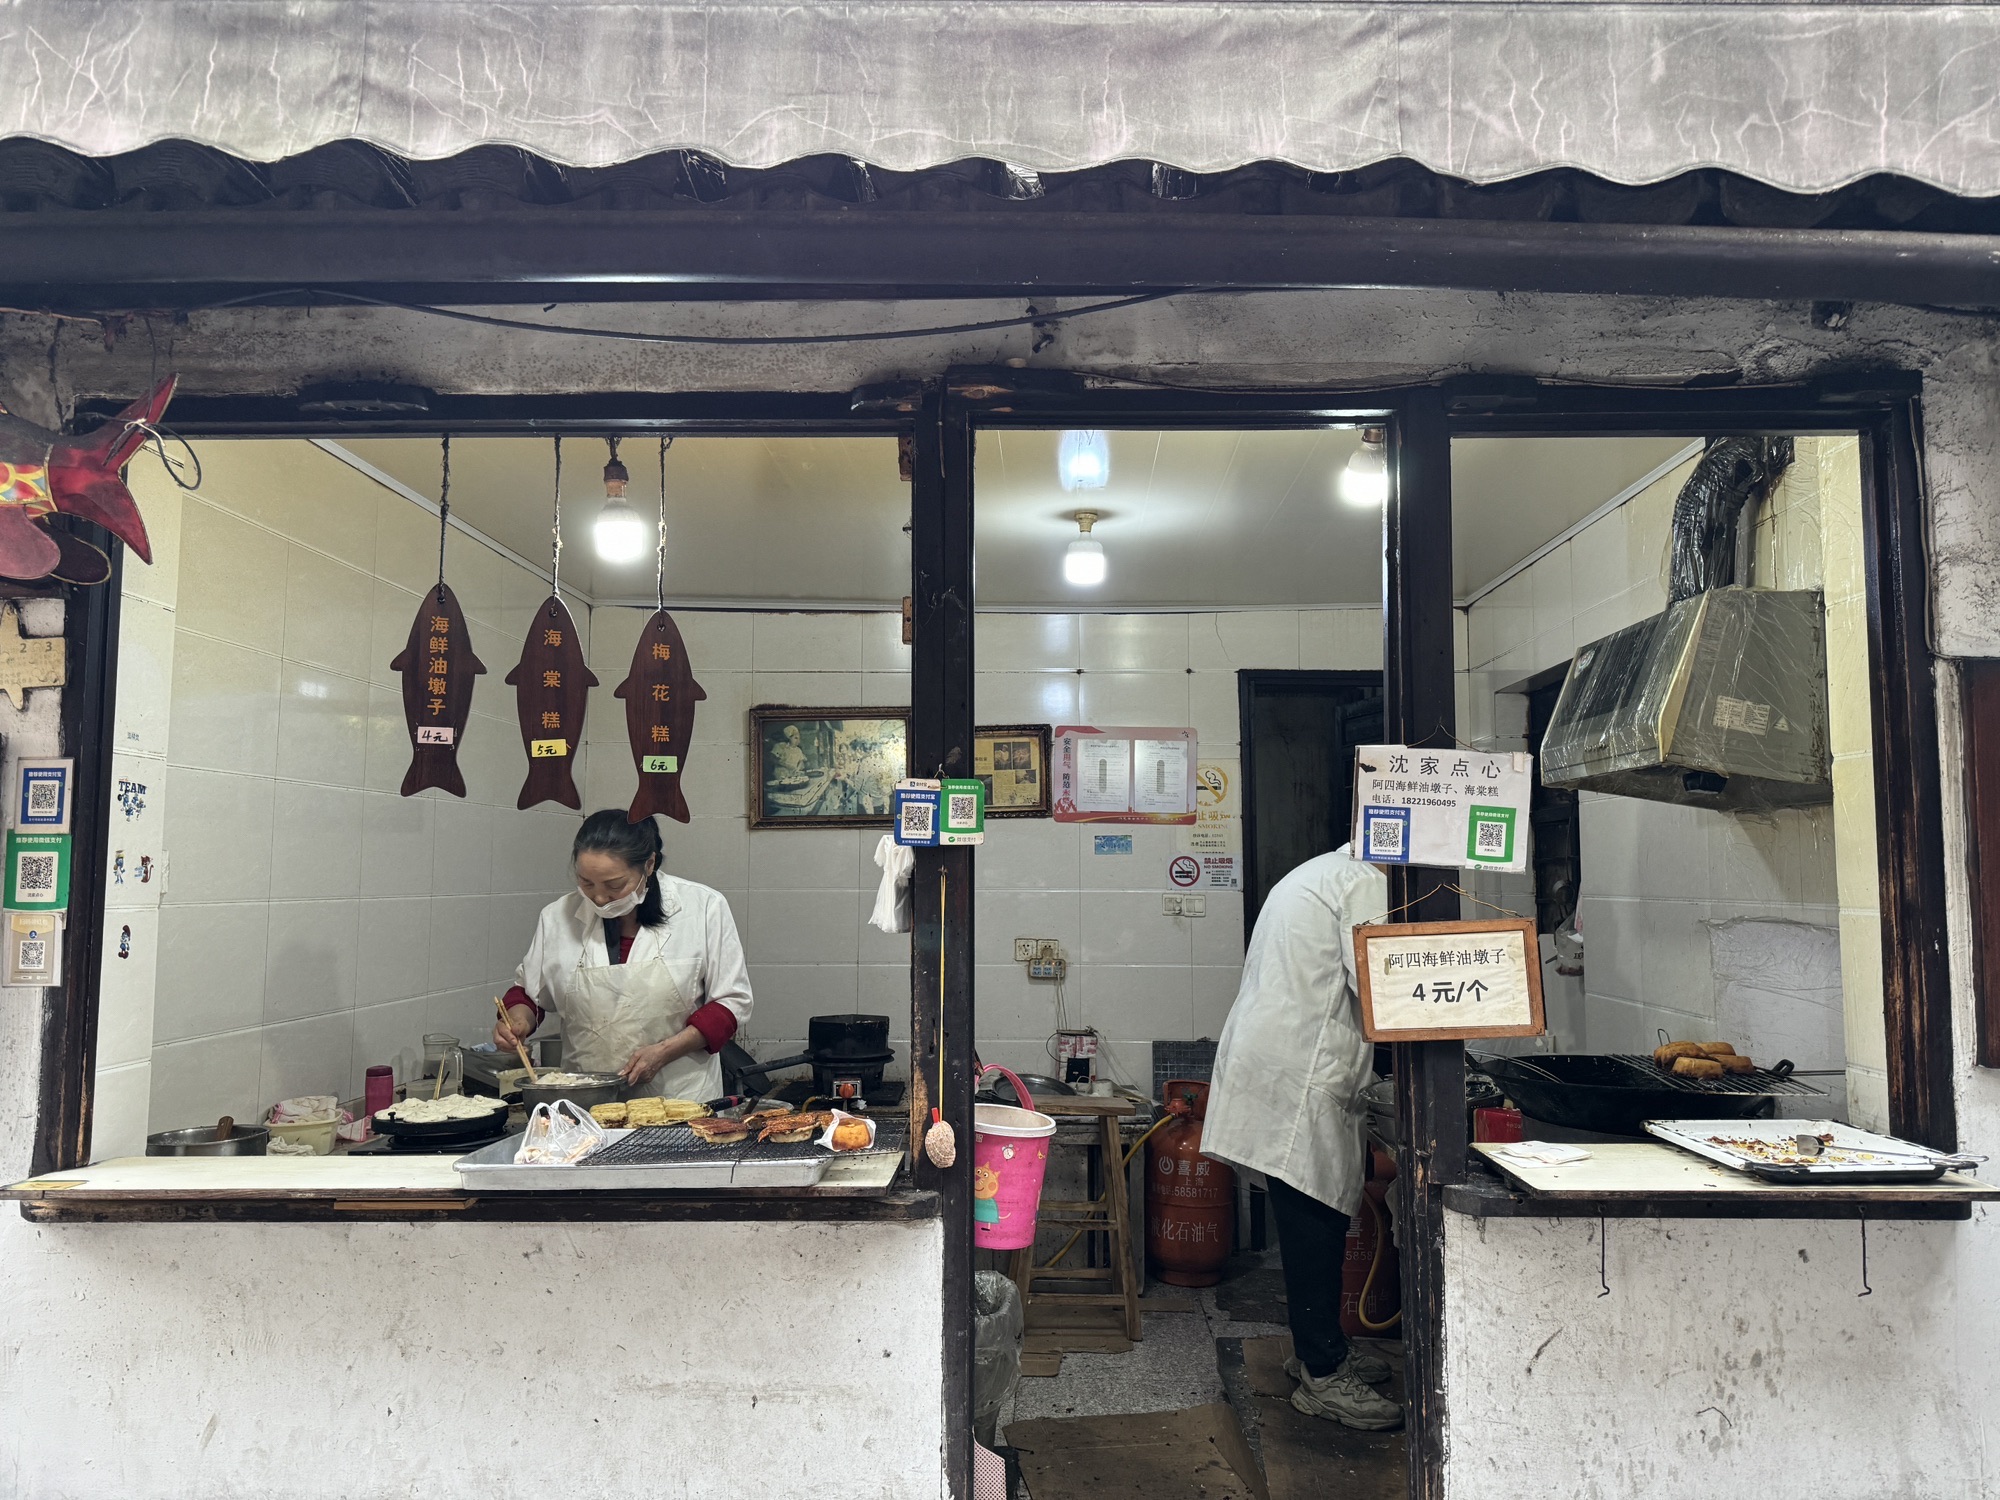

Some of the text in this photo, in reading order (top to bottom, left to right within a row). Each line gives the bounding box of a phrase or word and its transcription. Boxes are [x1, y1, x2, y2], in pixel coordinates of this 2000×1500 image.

[427, 616, 449, 715] 海鲜油墩子
[542, 629, 562, 729] 海棠糕
[651, 642, 670, 742] 梅花糕
[421, 729, 448, 742] 4元
[537, 744, 557, 755] 5元
[650, 758, 668, 771] 6元
[1389, 754, 1501, 779] 沈家点心
[119, 780, 147, 794] TEAM
[1372, 779, 1499, 797] 阿四海鲜油墩子、海棠糕
[1388, 948, 1506, 969] 阿四海鲜油墩子
[1177, 1160, 1210, 1176] 喜威
